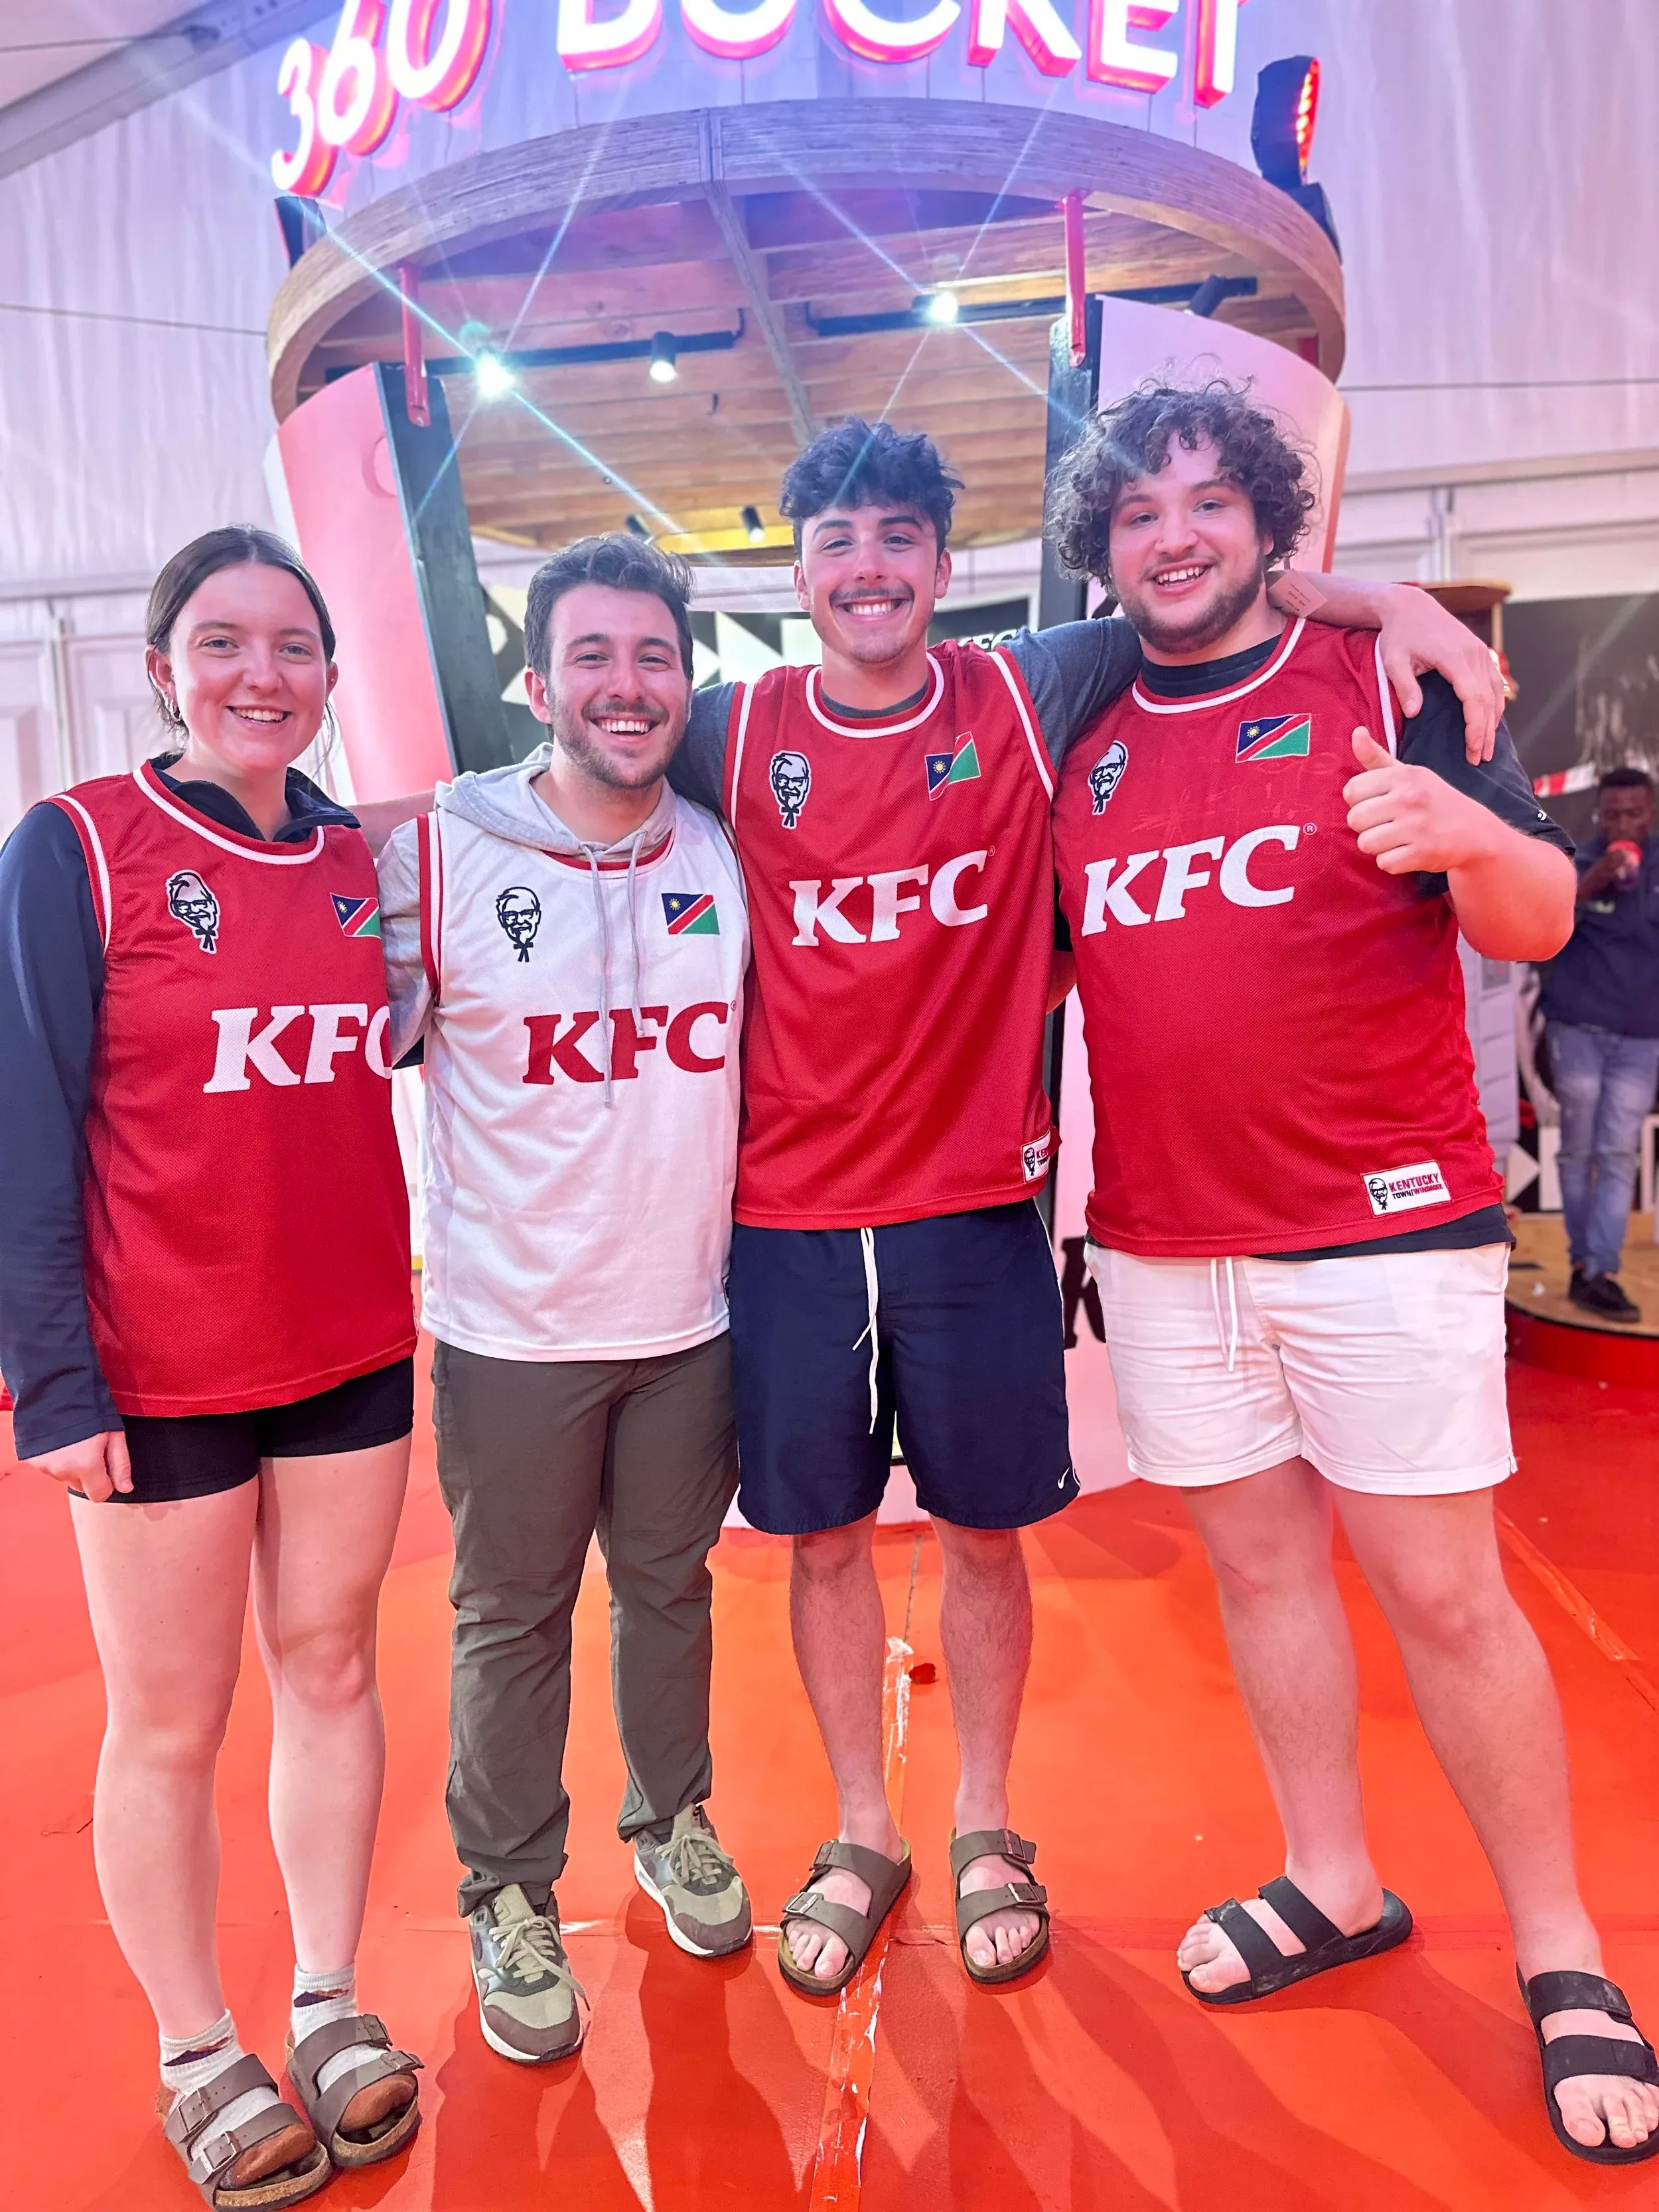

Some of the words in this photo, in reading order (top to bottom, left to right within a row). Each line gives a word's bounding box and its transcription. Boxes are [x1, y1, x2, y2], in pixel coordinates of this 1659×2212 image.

[788, 850, 988, 946] KFC
[1082, 824, 1301, 937] KFC
[522, 1001, 729, 1085] KFC
[1388, 1173, 1439, 1193] KENTUCKY
